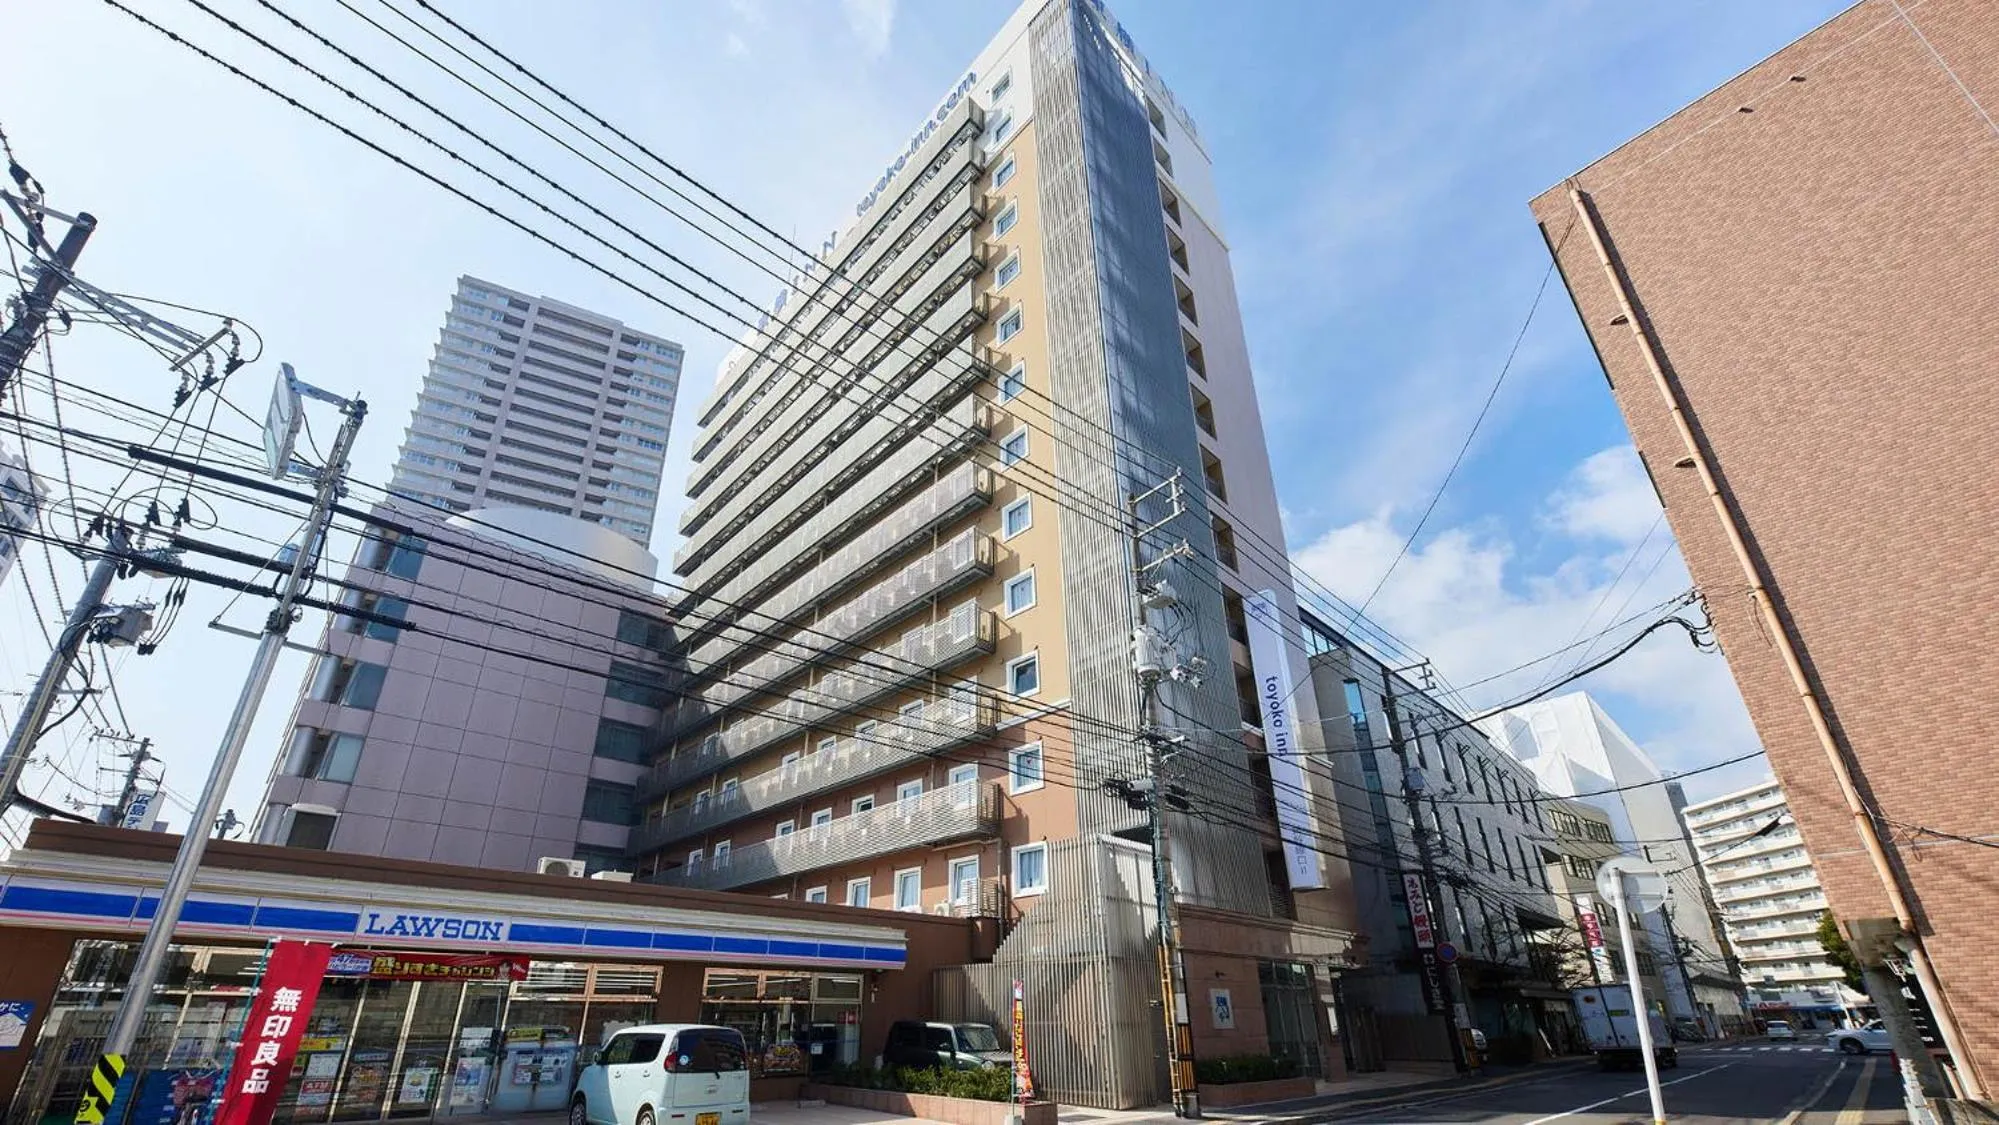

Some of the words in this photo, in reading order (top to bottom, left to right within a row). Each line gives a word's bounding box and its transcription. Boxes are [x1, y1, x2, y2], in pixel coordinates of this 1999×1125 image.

[1265, 676, 1285, 728] toyoko
[1275, 732, 1288, 757] inn
[365, 914, 503, 940] LAWSON
[241, 986, 303, 1094] 無印良品
